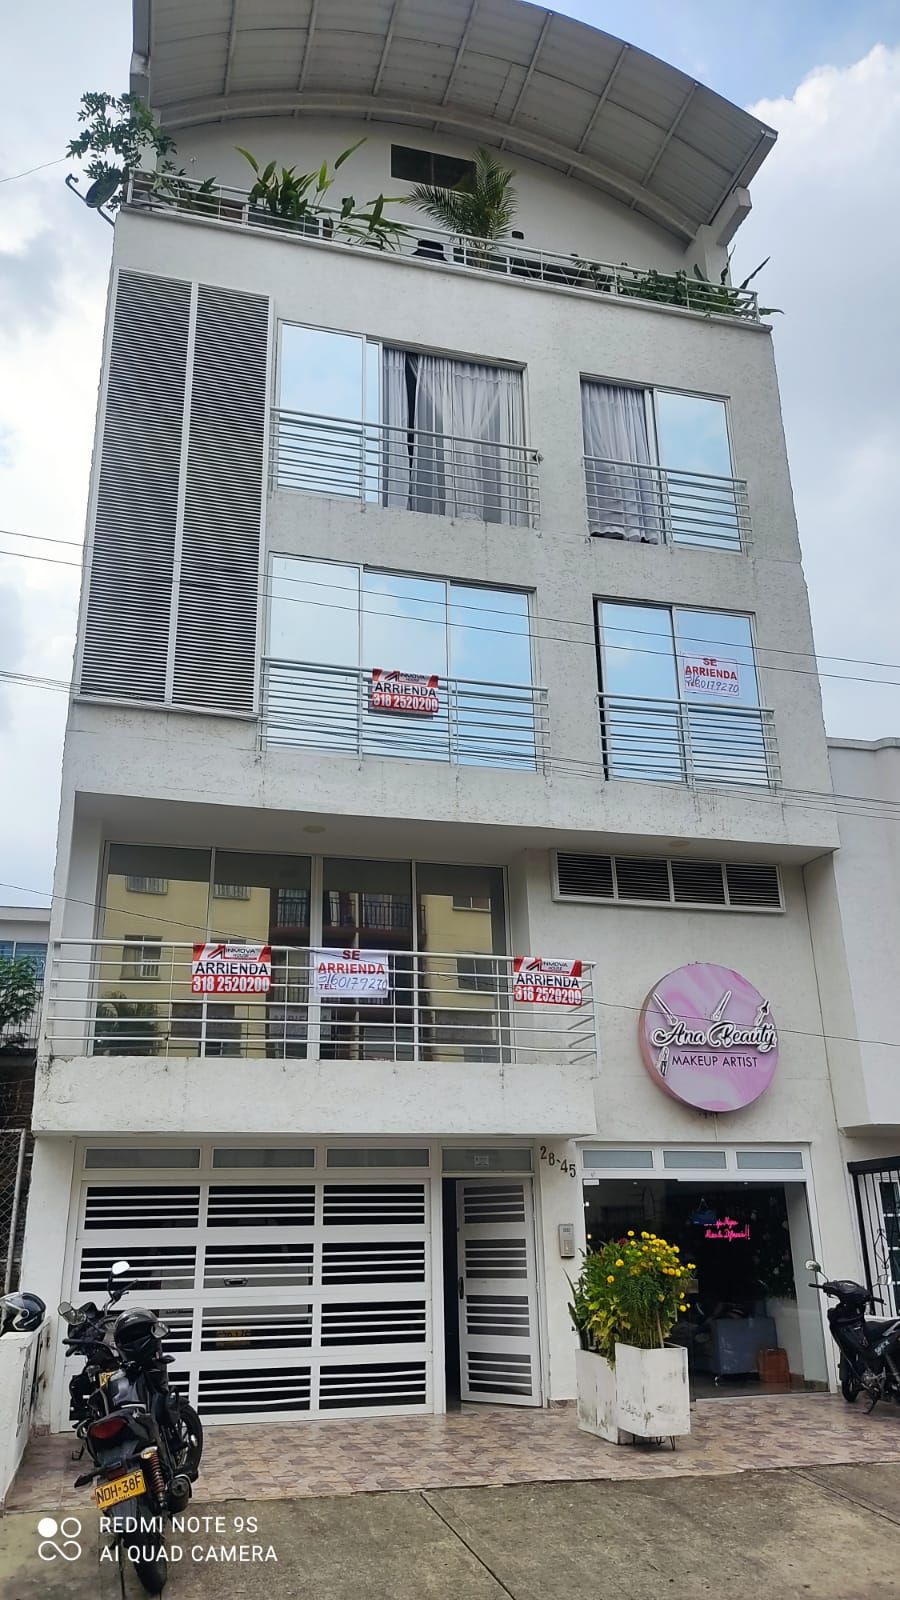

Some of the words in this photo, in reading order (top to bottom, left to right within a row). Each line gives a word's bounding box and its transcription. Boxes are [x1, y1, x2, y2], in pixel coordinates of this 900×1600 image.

[703, 657, 717, 667] SE
[685, 665, 738, 681] ARRIENDA
[375, 682, 437, 698] ARRIENDA
[373, 693, 392, 706] 318
[394, 695, 438, 712] 2520200
[342, 949, 361, 960] SE
[195, 962, 269, 975] ARRIENDA
[318, 962, 385, 975] ARRIENDA
[193, 976, 214, 992] 318
[217, 976, 270, 993] 2520200
[319, 983, 337, 991] TEL:
[516, 973, 580, 989] ARRIENDA
[515, 986, 535, 1001] 318
[536, 988, 582, 1005] 2520200
[652, 1021, 707, 1047] Ana
[708, 1021, 777, 1053] Beauty
[671, 1055, 719, 1067] MAKEUP
[722, 1056, 758, 1068] ARTIST
[540, 1145, 577, 1178] 28-45
